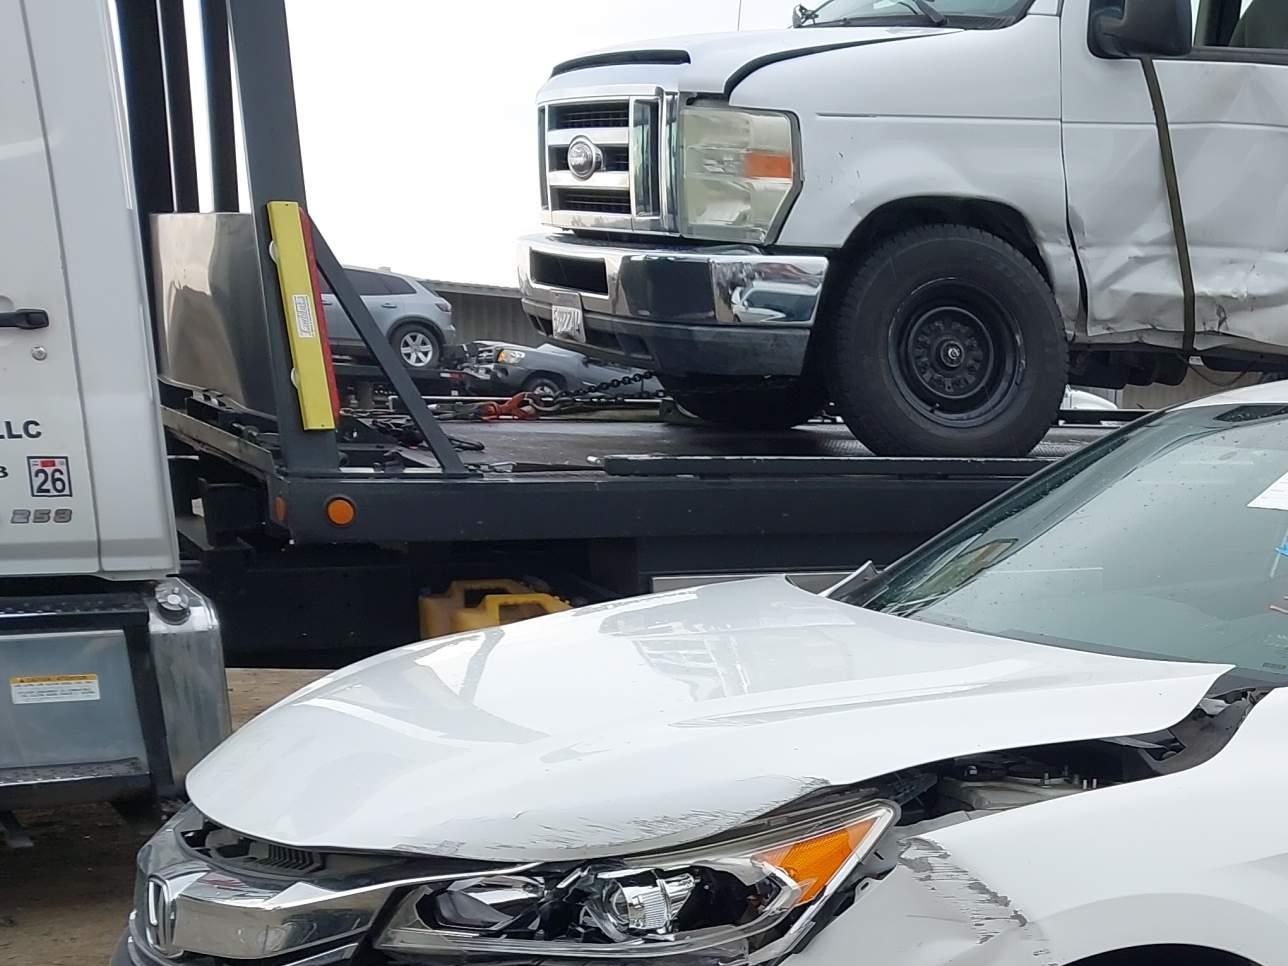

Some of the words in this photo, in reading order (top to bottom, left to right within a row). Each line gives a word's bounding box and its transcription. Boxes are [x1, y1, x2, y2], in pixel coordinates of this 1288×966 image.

[0, 420, 42, 439] LC
[34, 468, 66, 494] 26
[10, 508, 73, 525] 258
